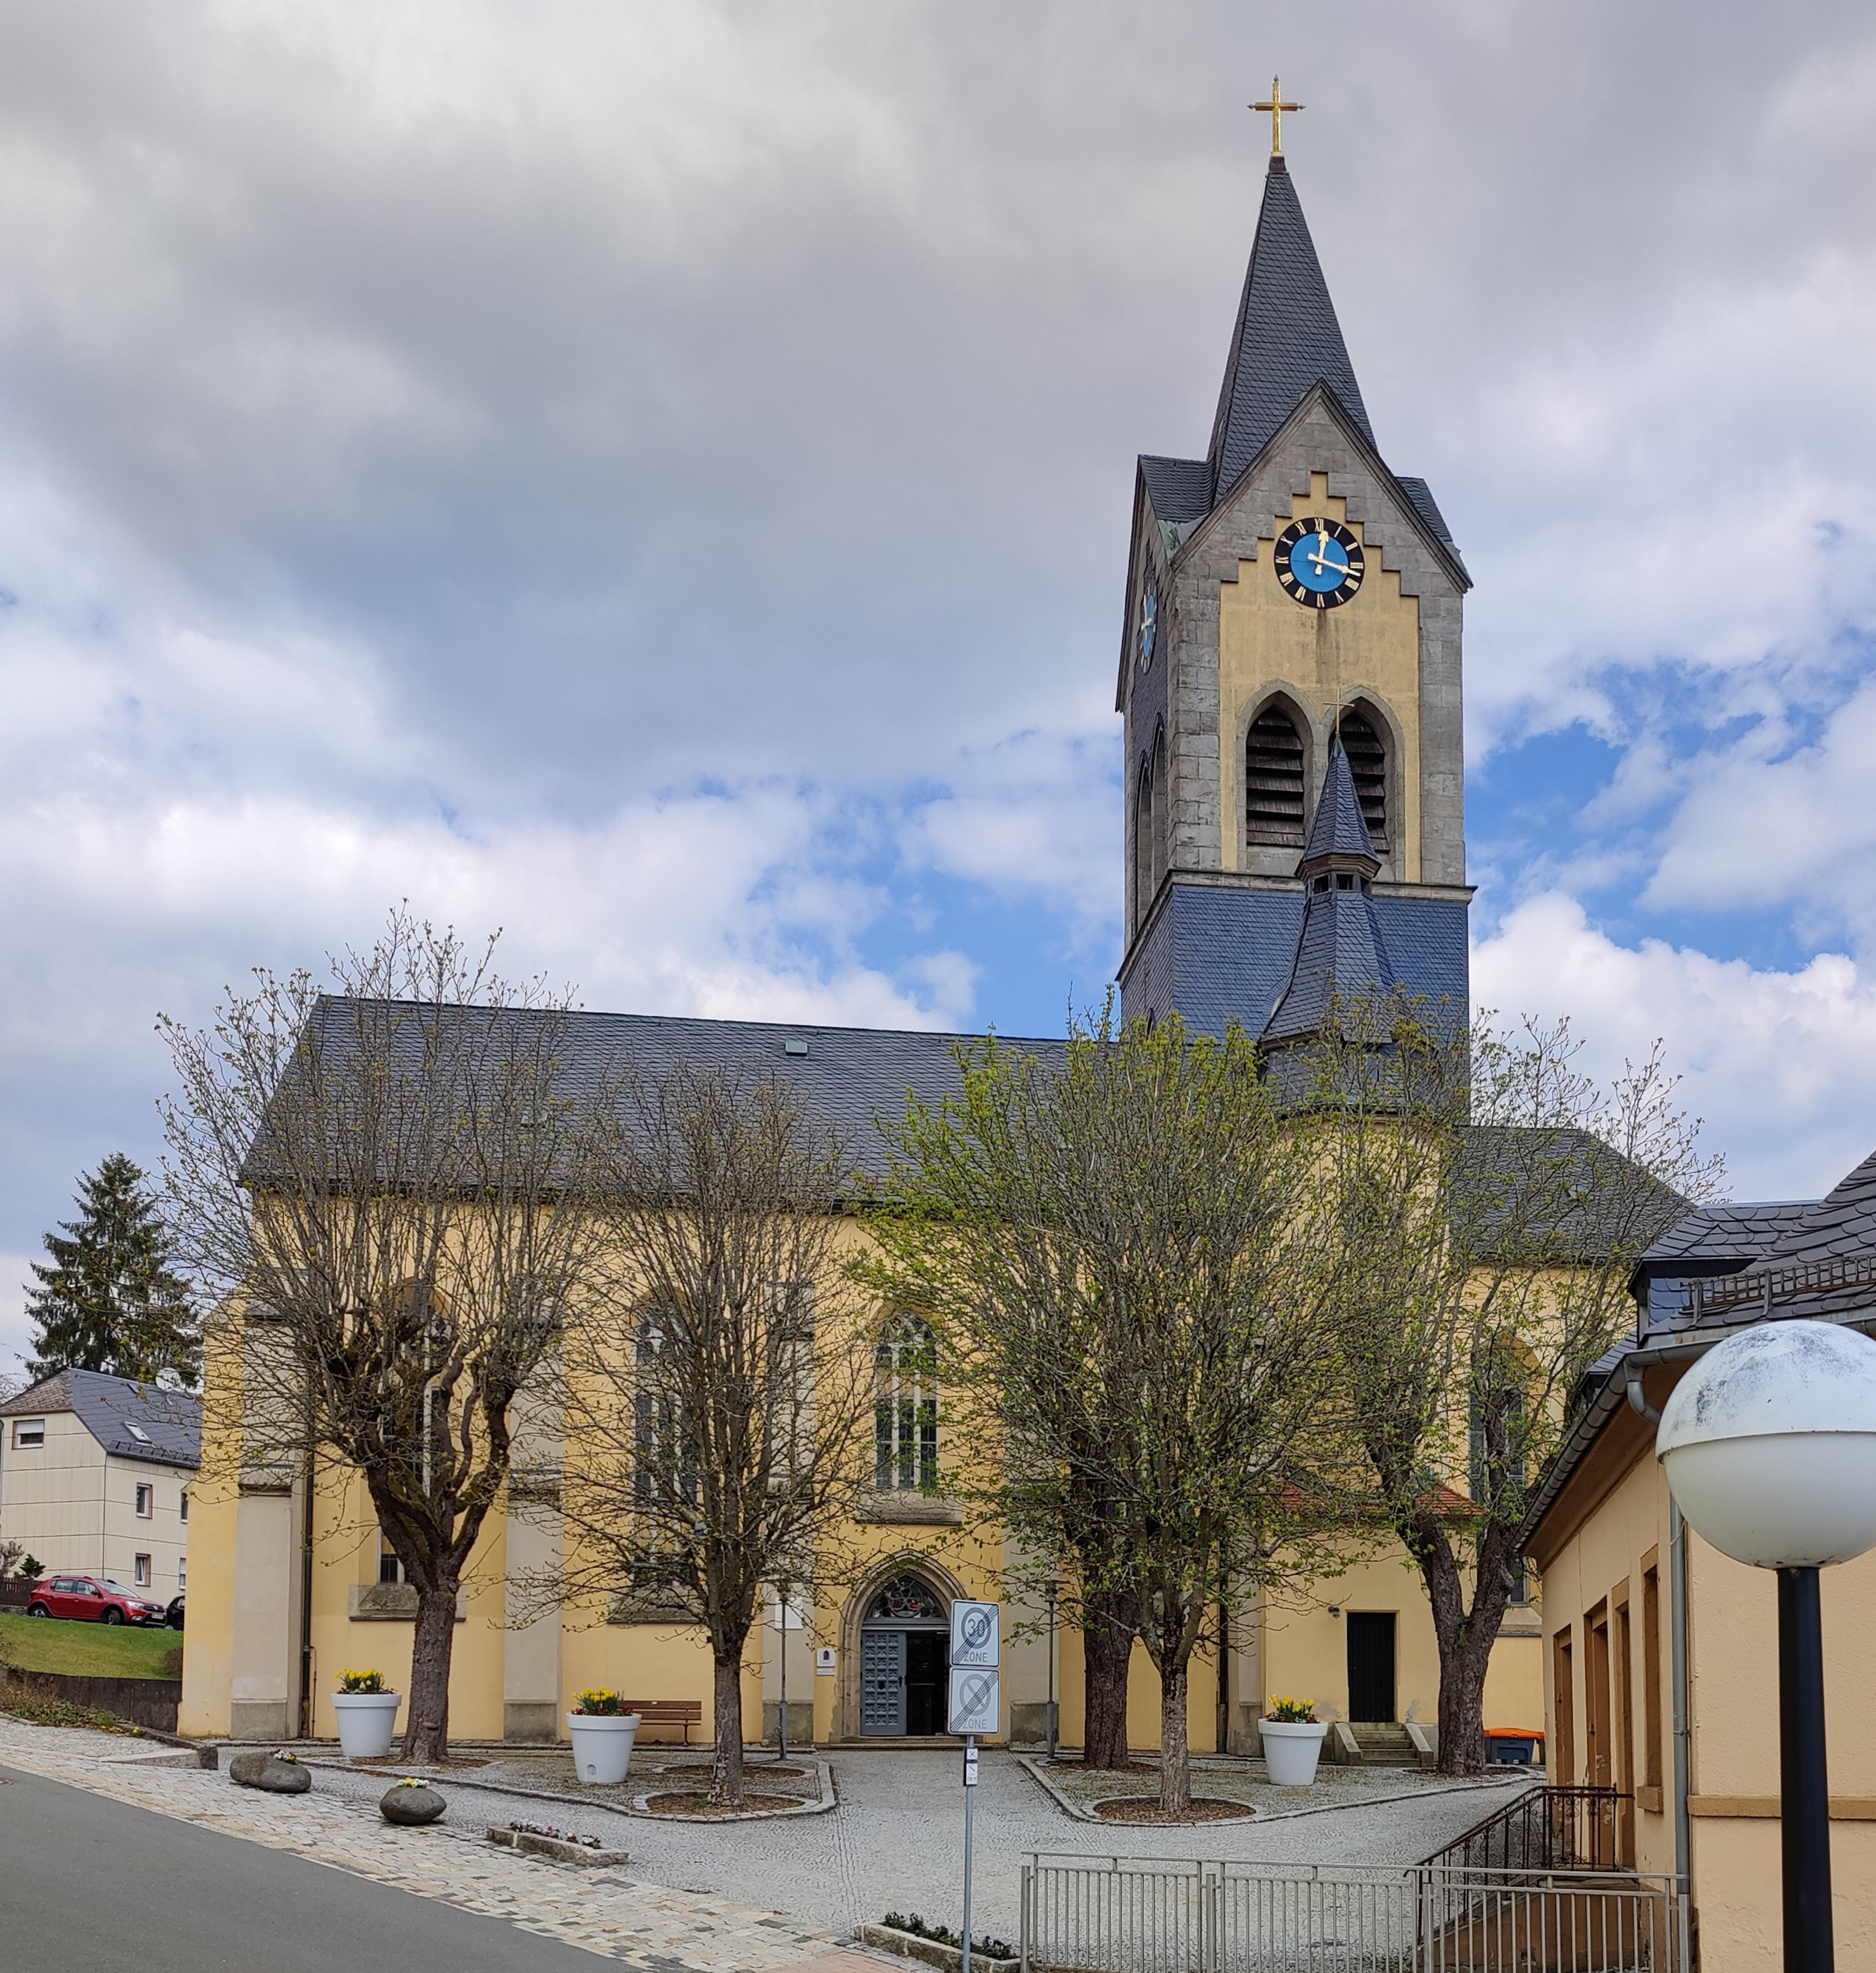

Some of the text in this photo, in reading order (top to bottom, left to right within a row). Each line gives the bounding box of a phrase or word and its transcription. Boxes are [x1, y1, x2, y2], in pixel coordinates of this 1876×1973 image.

[1295, 521, 1307, 536] XI
[1314, 518, 1324, 532] XII
[1333, 525, 1342, 537] I
[1280, 535, 1294, 547] X
[1345, 542, 1358, 551] II
[1275, 555, 1289, 564] IX
[1294, 586, 1306, 601] VII
[1334, 591, 1344, 603] V
[1317, 593, 1325, 607] VI
[968, 1619, 985, 1637] 30
[964, 1651, 988, 1662] ZONE
[963, 1718, 987, 1729] ZONE
